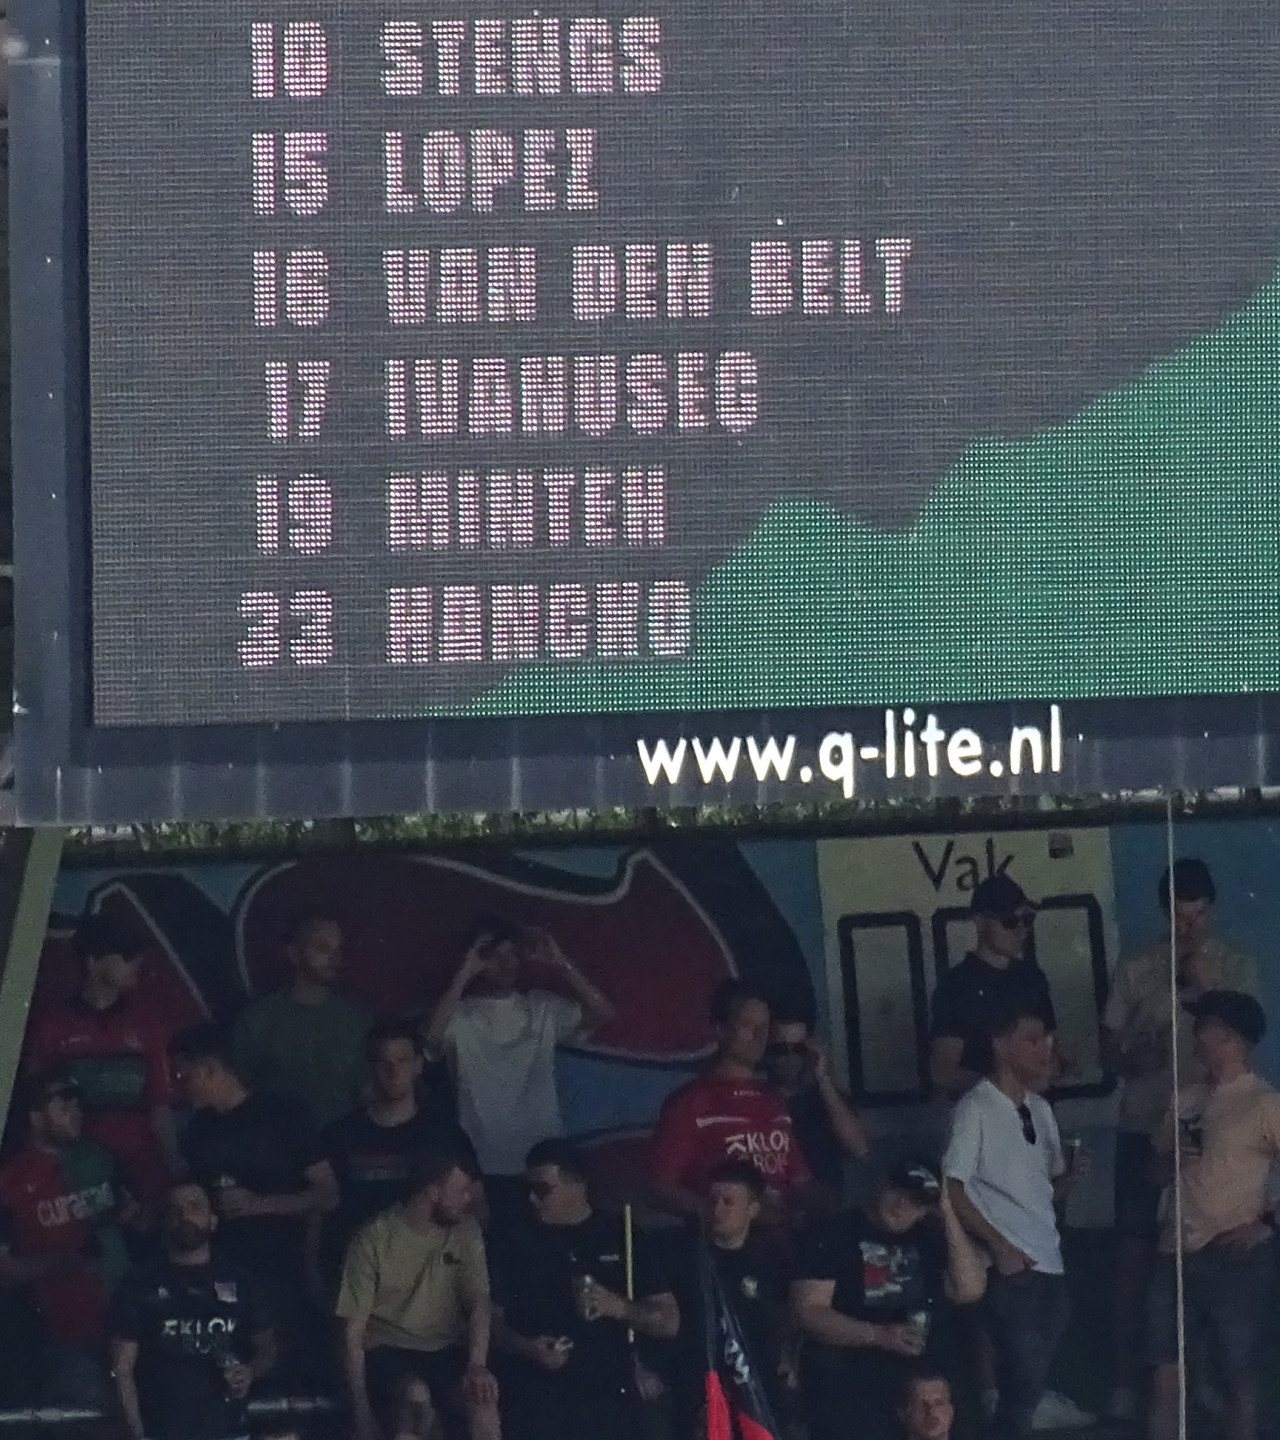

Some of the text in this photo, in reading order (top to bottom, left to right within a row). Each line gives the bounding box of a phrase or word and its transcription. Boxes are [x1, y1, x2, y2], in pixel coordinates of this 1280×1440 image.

[251, 17, 661, 98] 10 STENGS
[252, 128, 598, 215] 15 LOPEZ
[253, 238, 911, 326] 16 VAN DEN BELT
[265, 351, 758, 438] 17 IVANUSEC
[256, 467, 664, 555] 19 MINTEH
[237, 580, 691, 666] 33 HANCKO
[636, 704, 1063, 799] www.q-lite.nl
[912, 838, 1014, 890] Vak
